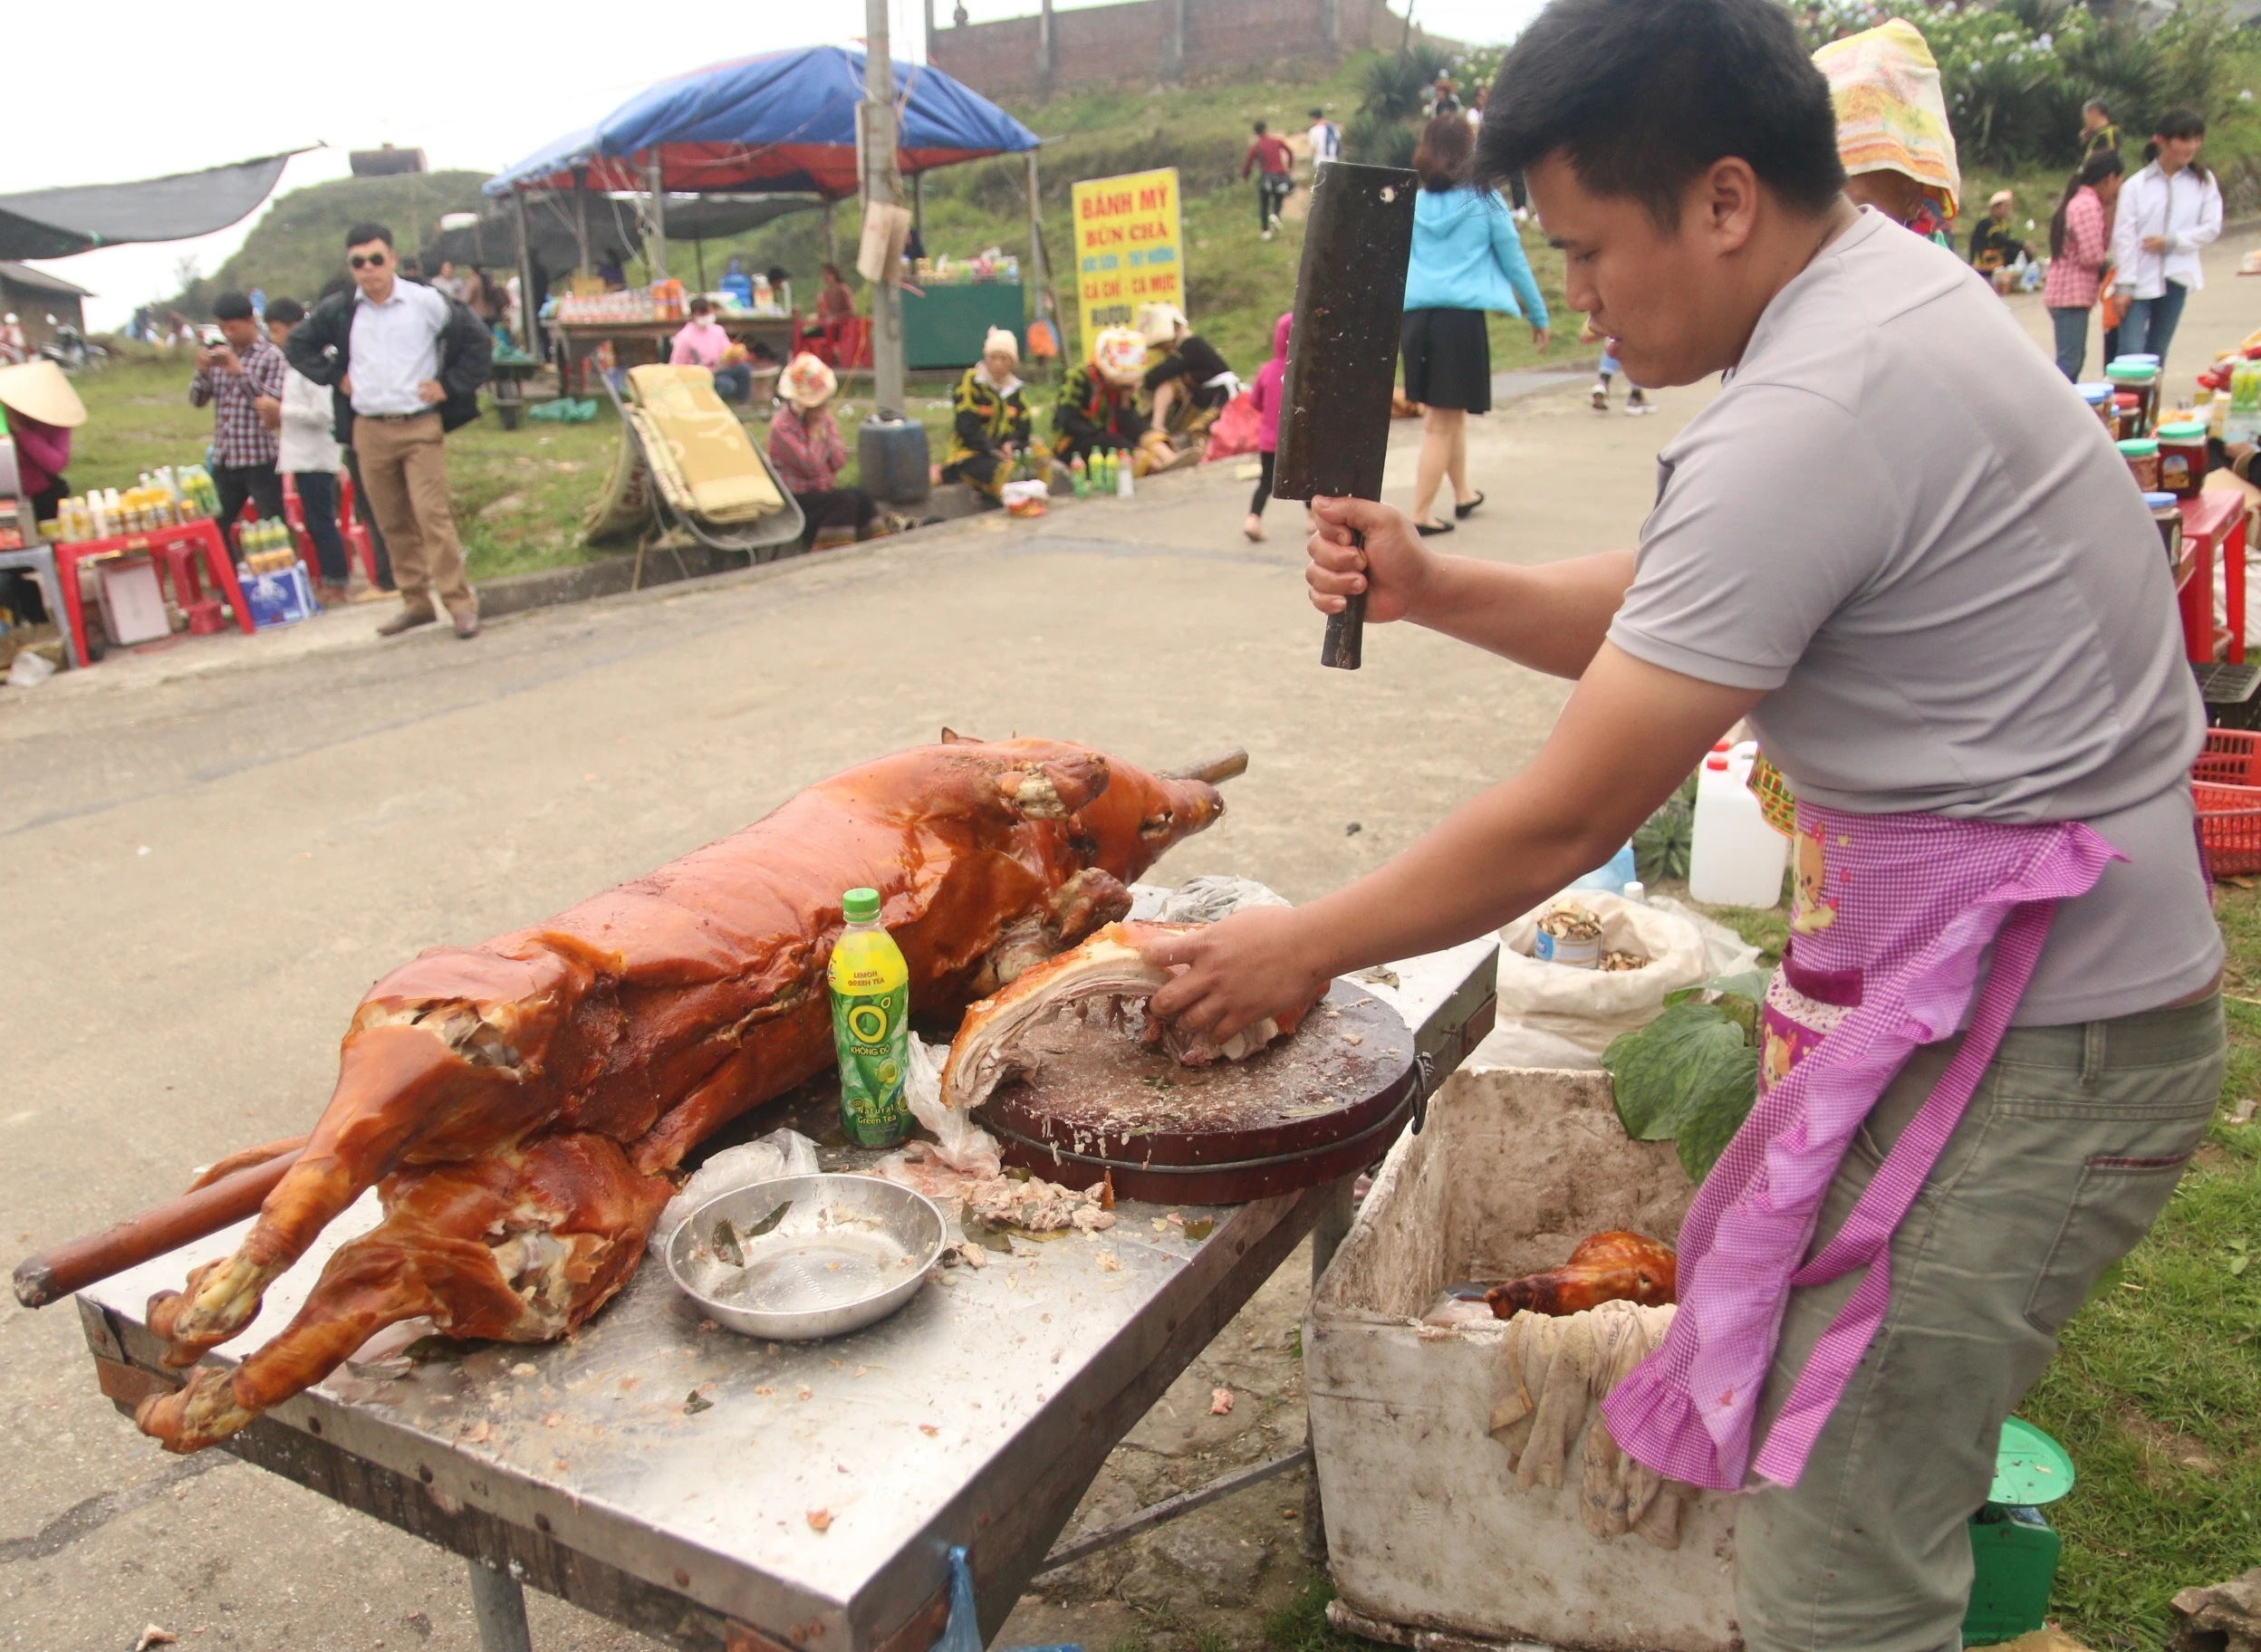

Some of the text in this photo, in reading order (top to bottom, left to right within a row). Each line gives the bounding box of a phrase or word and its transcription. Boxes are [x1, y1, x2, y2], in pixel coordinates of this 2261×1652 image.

[853, 970, 878, 979] LEMON
[847, 979, 871, 987] GREEN
[850, 1044, 879, 1056] KHÔNG
[858, 1103, 894, 1114] Natural
[857, 1115, 897, 1124] Green Tea
